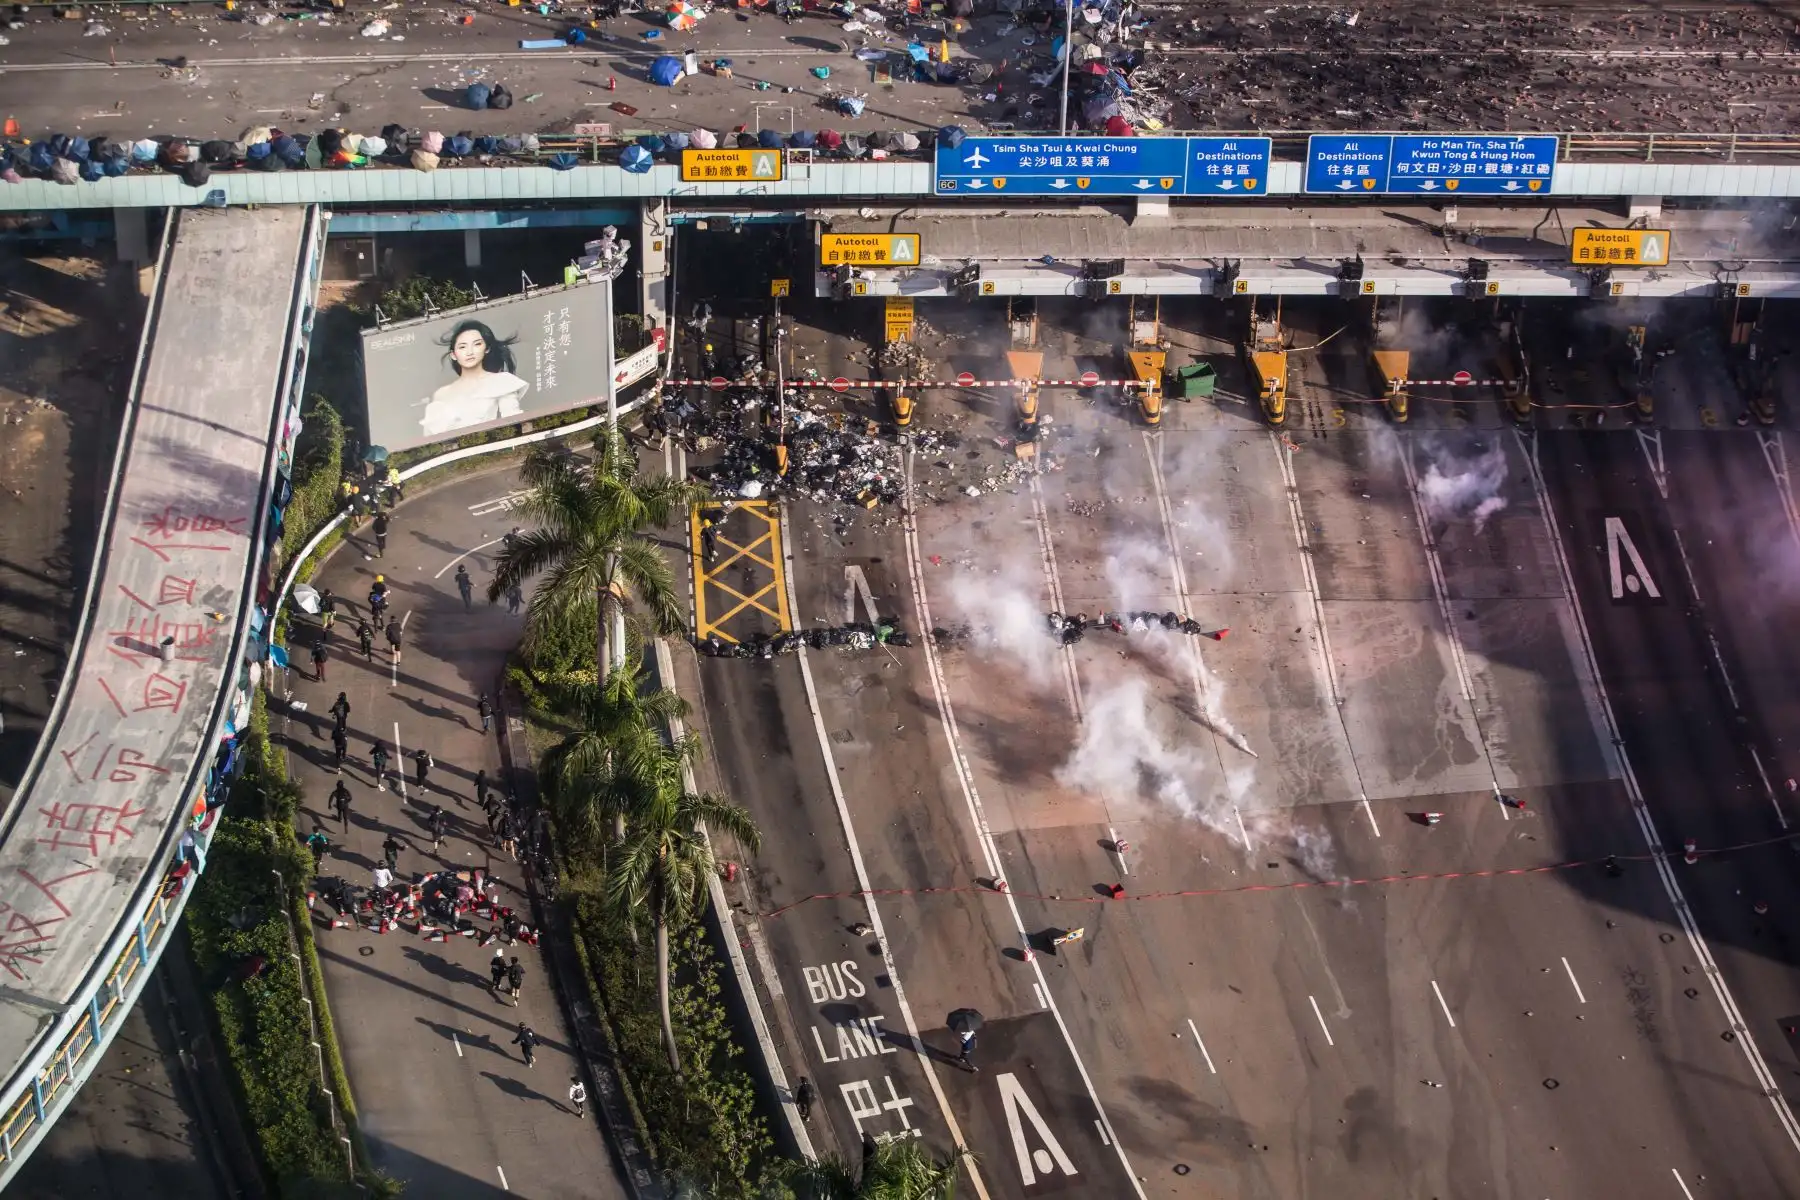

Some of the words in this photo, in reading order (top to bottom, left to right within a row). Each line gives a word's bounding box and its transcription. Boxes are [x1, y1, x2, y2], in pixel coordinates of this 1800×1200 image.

[993, 144, 1016, 153] Tsim
[1019, 144, 1039, 153] Sha
[1042, 144, 1063, 153] Tsui
[1065, 144, 1073, 153] &
[1075, 144, 1101, 153] Kwai
[1103, 144, 1137, 154] Chung
[1222, 142, 1237, 151] All
[1344, 142, 1359, 151] All
[1422, 141, 1438, 149] Ho
[1441, 141, 1463, 149] Man
[1486, 141, 1507, 150] Sha
[1509, 142, 1525, 150] Tin
[697, 153, 739, 161] Autotoll
[1196, 152, 1263, 161] Destinations
[1318, 152, 1384, 161] Destinations
[1411, 150, 1441, 159] Kwun
[1443, 150, 1468, 161] Tong
[1470, 151, 1478, 159] &
[1480, 151, 1508, 161] Hung
[1511, 151, 1535, 160] Hom
[755, 155, 773, 176] A
[1019, 156, 1110, 168] 尖沙咀及葵涌
[690, 165, 748, 177] 自動繳費
[1206, 164, 1250, 176] 往各區
[1327, 164, 1371, 176] 往各區
[940, 181, 955, 189] 6C
[835, 237, 879, 246] Autotoll
[1587, 233, 1630, 242] Autotoll
[894, 239, 912, 260] A
[1643, 236, 1661, 260] A
[829, 250, 887, 261] 自動繳費
[1580, 246, 1636, 260] 自動繳費
[857, 284, 864, 293] 1
[985, 283, 993, 292] 2
[1112, 283, 1119, 292] 3
[1237, 282, 1245, 291] 4
[1365, 283, 1373, 292] 5
[1489, 283, 1497, 292] 6
[1615, 284, 1622, 293] 7
[1740, 284, 1748, 294] 8
[1605, 517, 1661, 599] A
[803, 960, 866, 1003] BUS
[811, 1015, 897, 1063] LANE
[996, 1072, 1078, 1186] A
